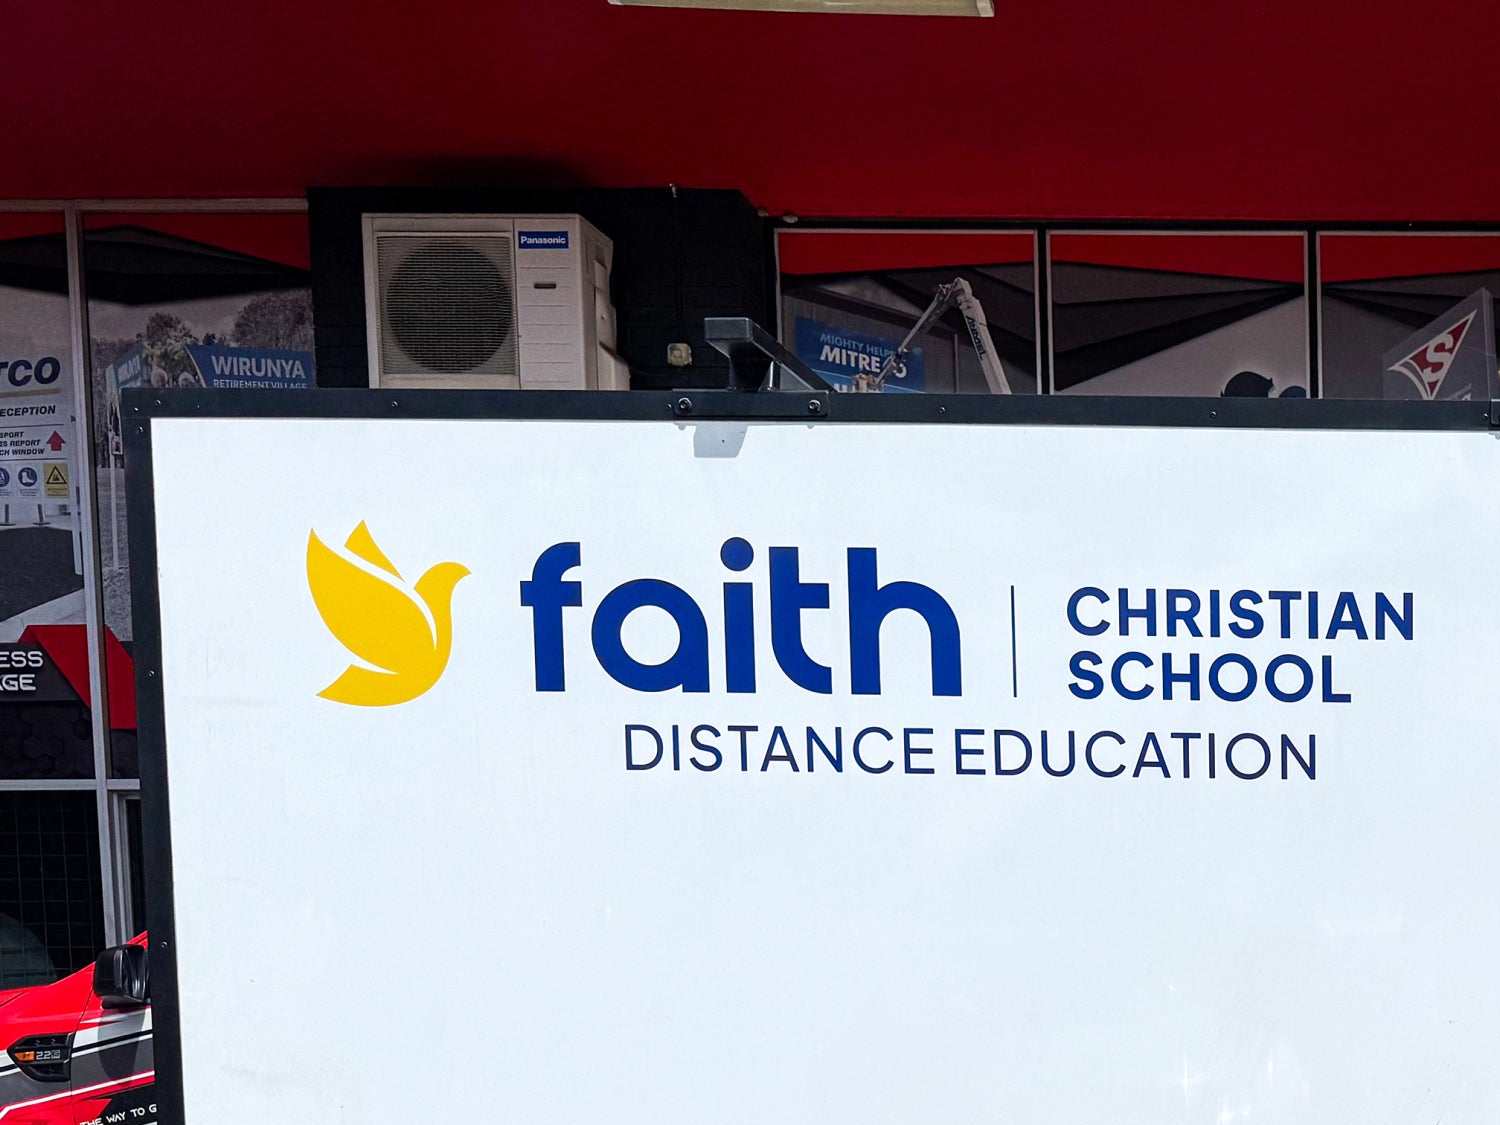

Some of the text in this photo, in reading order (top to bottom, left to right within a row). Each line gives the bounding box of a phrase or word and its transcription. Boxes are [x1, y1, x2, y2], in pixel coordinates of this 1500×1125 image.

[520, 235, 566, 244] Panasonic
[820, 333, 864, 351] MIGHTY
[211, 355, 306, 379] WIRUNYA
[820, 345, 881, 373] MITRE
[10, 439, 41, 447] REPORT
[12, 448, 45, 456] WINDOW
[520, 537, 962, 696] faith
[1067, 587, 1414, 640] CHRISTIAN
[1067, 651, 1352, 704] SCHOOL
[624, 725, 1316, 780] DISTANCE EDUCATION
[106, 1111, 126, 1123] WAY
[130, 1107, 146, 1117] TO
